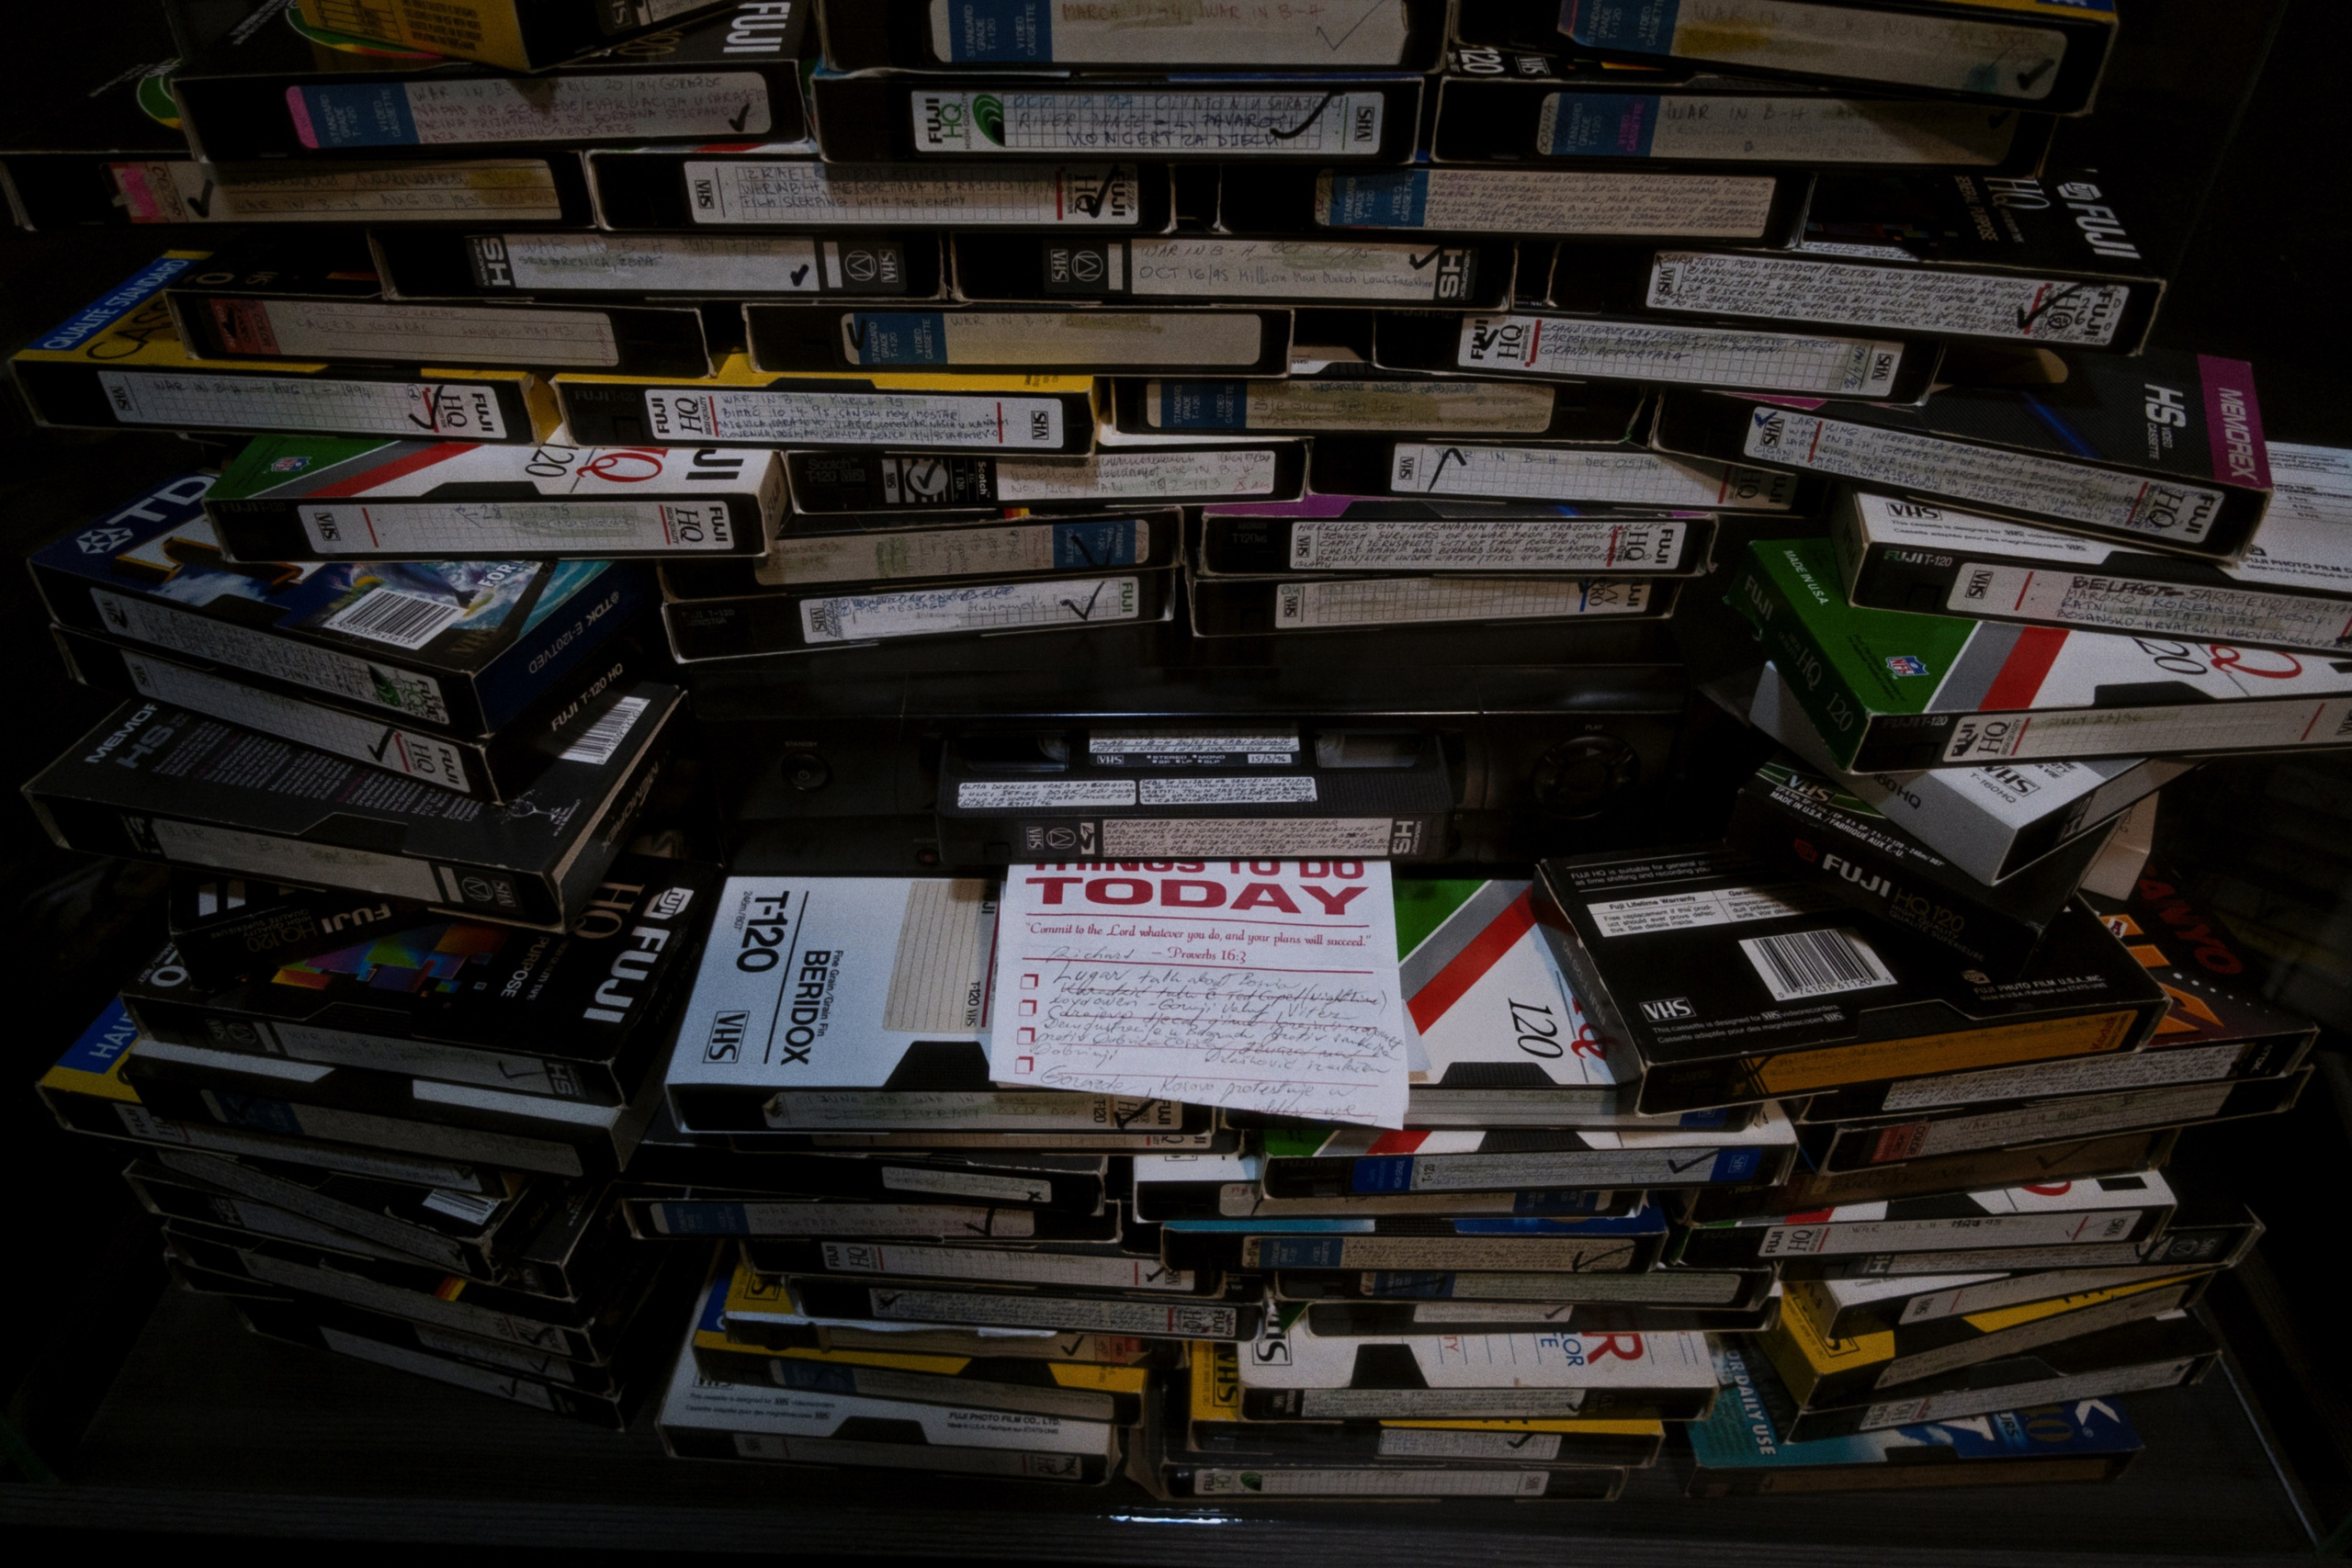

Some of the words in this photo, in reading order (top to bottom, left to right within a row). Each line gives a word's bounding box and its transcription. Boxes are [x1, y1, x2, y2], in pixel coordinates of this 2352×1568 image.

[723, 2, 790, 53] FUJI
[965, 4, 975, 58] STANDARD
[1460, 48, 1504, 74] 120
[1518, 56, 1549, 75] VHS
[925, 97, 943, 143] FUJI
[942, 104, 963, 139] HQ
[1018, 113, 1077, 128] RIVER
[1357, 108, 1373, 140] VHS
[1667, 105, 1709, 120] WAR
[696, 180, 714, 209] VHS
[856, 197, 888, 207] WITH
[894, 197, 920, 207] THE
[924, 196, 966, 206] ENEMY
[2066, 201, 2143, 260] FUJI
[480, 237, 504, 288] HS
[881, 250, 897, 281] VHS
[1051, 250, 1068, 281] VHS
[1438, 249, 1464, 299] HS
[1657, 267, 1673, 294] VHS
[43, 310, 111, 350] QUALITÉ
[115, 259, 190, 309] STANDARD
[1498, 324, 1524, 360] HQ
[1873, 355, 1893, 379] VHS
[110, 387, 130, 412] VHS
[472, 393, 494, 433] FUJI
[650, 397, 669, 434] FUJI
[2145, 383, 2187, 428] HS
[676, 398, 703, 434] HQ
[1033, 412, 1047, 439] VHS
[1763, 418, 1784, 446] VHS
[2146, 423, 2161, 460] CASSETTE
[2217, 388, 2258, 481] MEMOREX
[977, 460, 988, 497] Scotch
[1400, 457, 1413, 480] VHS
[316, 513, 340, 540] VHS
[676, 508, 705, 543] HQ
[709, 506, 729, 543] FUJI
[1889, 502, 1940, 519] VHS
[2185, 495, 2215, 535] FUJI
[1296, 536, 1310, 558] VHS
[1656, 529, 1674, 564] FUJI
[1924, 556, 1952, 568] T-120
[1782, 549, 1804, 575] MADE
[1797, 570, 1812, 584] IN
[1122, 581, 1134, 613] FUJI
[1745, 574, 1774, 621] FUJI
[1970, 572, 1991, 597] VHS
[812, 608, 824, 632] VHS
[550, 702, 580, 731] FUJI
[581, 678, 607, 705] T-120
[604, 662, 625, 684] HQ
[1826, 692, 1855, 733] 120
[115, 724, 175, 770] HS
[1977, 722, 2011, 754] HQ
[410, 741, 434, 774] HQ
[437, 748, 459, 784] FUJI
[1789, 774, 1835, 804] VHS
[1770, 791, 1792, 808] MADE
[1802, 806, 1824, 822] U.S.A.
[1828, 816, 1868, 841] FABRIQUÉ
[1867, 835, 1883, 849] AUX
[1028, 829, 1042, 849] VHS
[1393, 820, 1413, 854] HS
[1229, 861, 1281, 876] TO
[1299, 861, 1364, 879] DO
[1570, 870, 1589, 880] FUJI
[1618, 865, 1651, 875] suitable
[1665, 861, 1696, 871] general
[1606, 873, 1638, 884] shifting
[1655, 867, 1694, 879] recording
[1822, 853, 1892, 898] FUJI
[492, 881, 516, 908] VHS
[1025, 876, 1370, 915] TODAY
[1626, 899, 1660, 910] Lifetime
[1661, 895, 1697, 907] Warranty
[1894, 886, 1930, 918] HQ
[1932, 904, 1965, 933] 120
[321, 904, 392, 934] FUJI
[737, 891, 790, 973] T-120
[1076, 923, 1084, 934] to
[1087, 923, 1102, 935] the
[1106, 924, 1136, 937] Lord
[1139, 926, 1184, 939] whatever
[1187, 931, 1205, 943] you
[1208, 929, 1222, 942] do,
[1226, 930, 1245, 941] and
[1247, 934, 1271, 945] your
[1273, 932, 1301, 946] plans
[1305, 934, 1323, 945] will
[500, 936, 551, 999] PURPOSE
[833, 950, 843, 971] Fine
[1167, 947, 1216, 961] Proverbs
[1221, 949, 1247, 964] 16:3
[582, 926, 672, 1023] FUJI
[1796, 982, 1833, 996] 74101
[1836, 976, 1873, 991] 61120
[1973, 985, 1996, 995] FUJI
[1997, 982, 2030, 992] PHOTO
[2032, 978, 2056, 988] FILM
[781, 951, 831, 1066] BERIDOX
[823, 973, 840, 1020] Grain/Grain
[967, 981, 980, 1006] T-120
[1642, 998, 1692, 1020] VHS
[708, 1013, 746, 1060] VHS
[817, 1023, 828, 1037] Fin
[1509, 998, 1564, 1058] 120
[1652, 1026, 1671, 1035] This
[1672, 1022, 1705, 1033] cassette
[1713, 1017, 1748, 1030] designed
[1748, 1016, 1762, 1024] for
[1657, 1033, 1693, 1043] Cassette
[1694, 1029, 1727, 1042] adaptée
[1761, 1017, 1824, 1032] magnétoscopes
[1765, 1231, 1784, 1253] FUJI
[1788, 1230, 1815, 1252] HQ
[1739, 1378, 1763, 1422] DAILY
[968, 1413, 1000, 1423] PHOTO
[1002, 1414, 1022, 1424] FILM
[1750, 1423, 1777, 1456] USE
